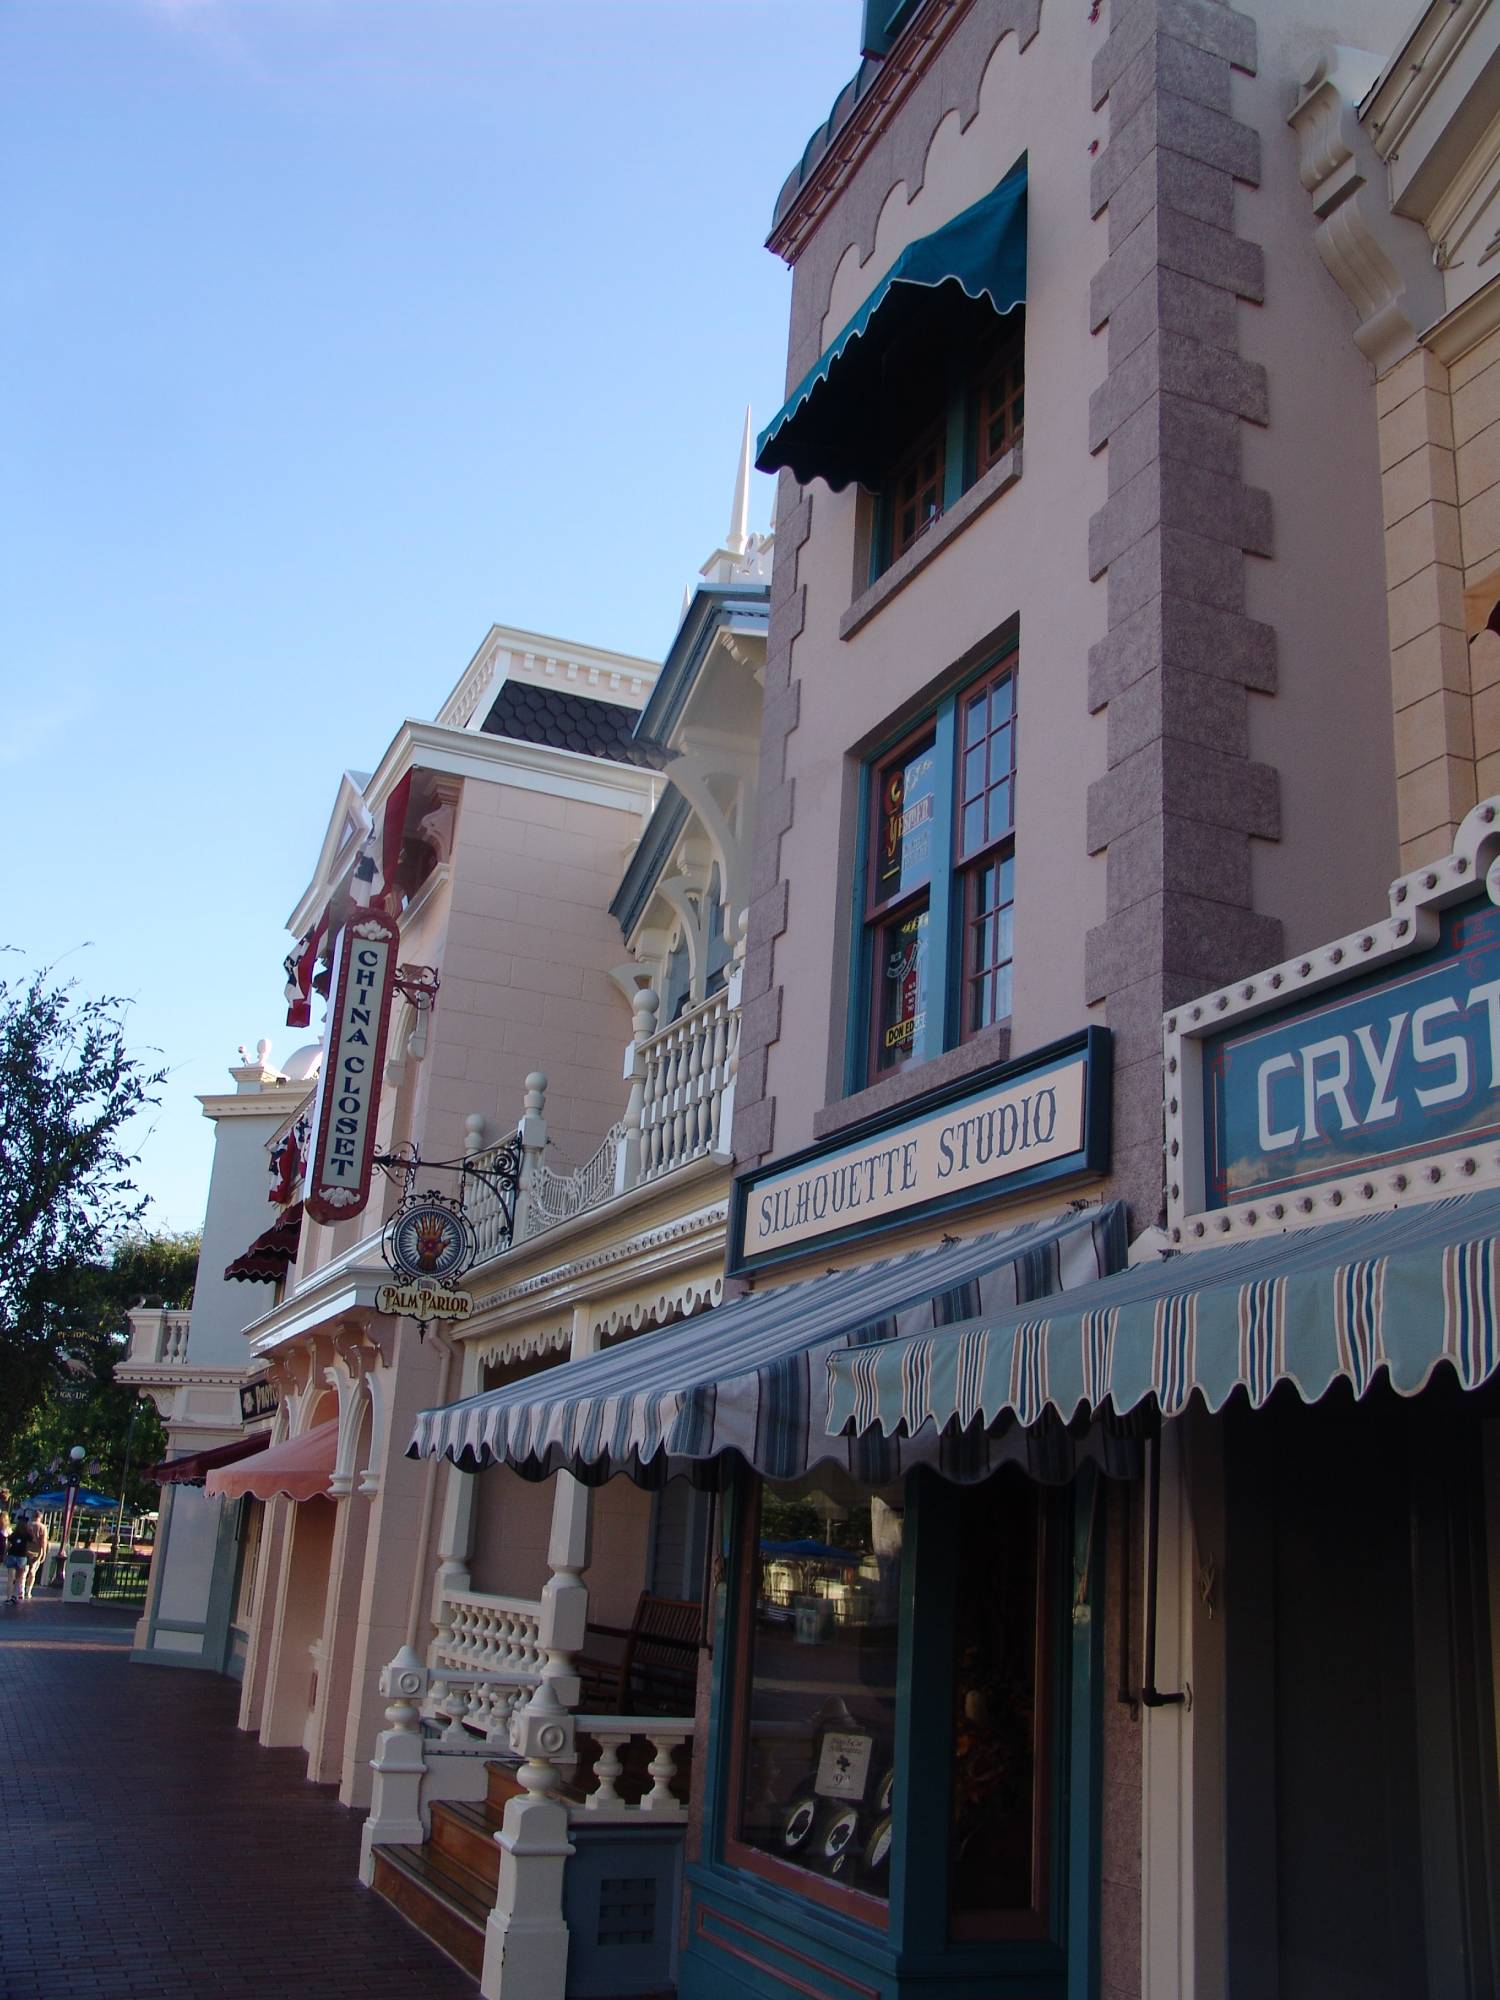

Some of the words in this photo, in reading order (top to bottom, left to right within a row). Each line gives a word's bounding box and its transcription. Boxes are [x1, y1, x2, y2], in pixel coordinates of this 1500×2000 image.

[346, 950, 378, 1046] CHINA
[888, 1025, 904, 1043] DON
[331, 1056, 365, 1177] CLOSET
[758, 1140, 919, 1238] SILHOUETTE
[937, 1085, 1057, 1179] STUDIO
[383, 1287, 418, 1311] PALM
[419, 1290, 468, 1318] PARLOR
